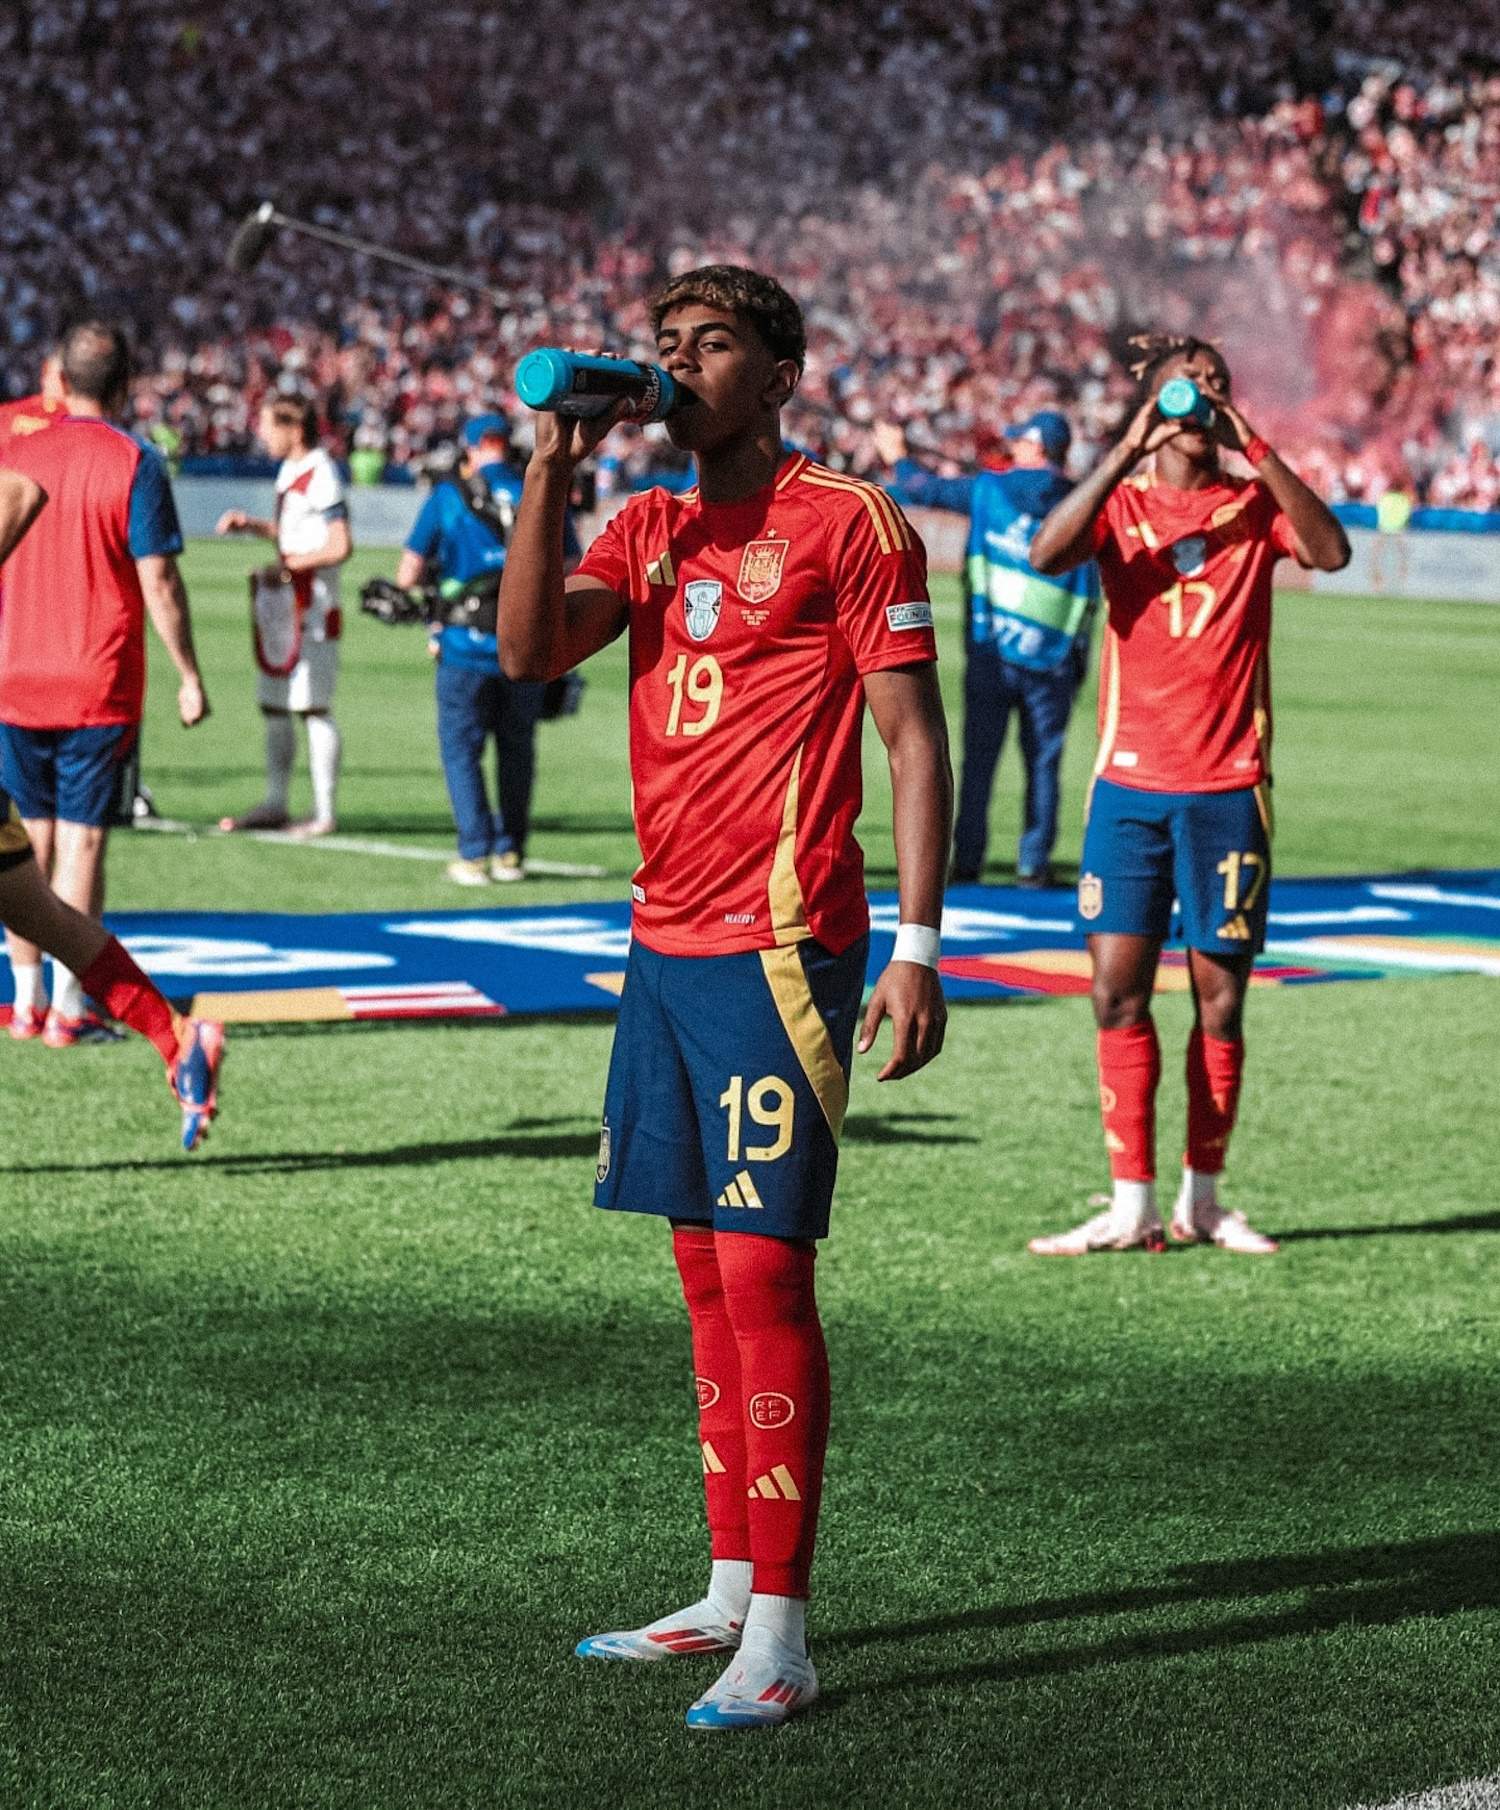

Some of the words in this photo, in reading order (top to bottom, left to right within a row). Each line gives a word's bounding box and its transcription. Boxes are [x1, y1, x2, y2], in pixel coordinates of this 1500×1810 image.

[648, 368, 660, 411] POWER
[1160, 581, 1217, 638] 17
[665, 654, 724, 737] 19
[1216, 851, 1266, 911] 17
[719, 1075, 795, 1161] 19
